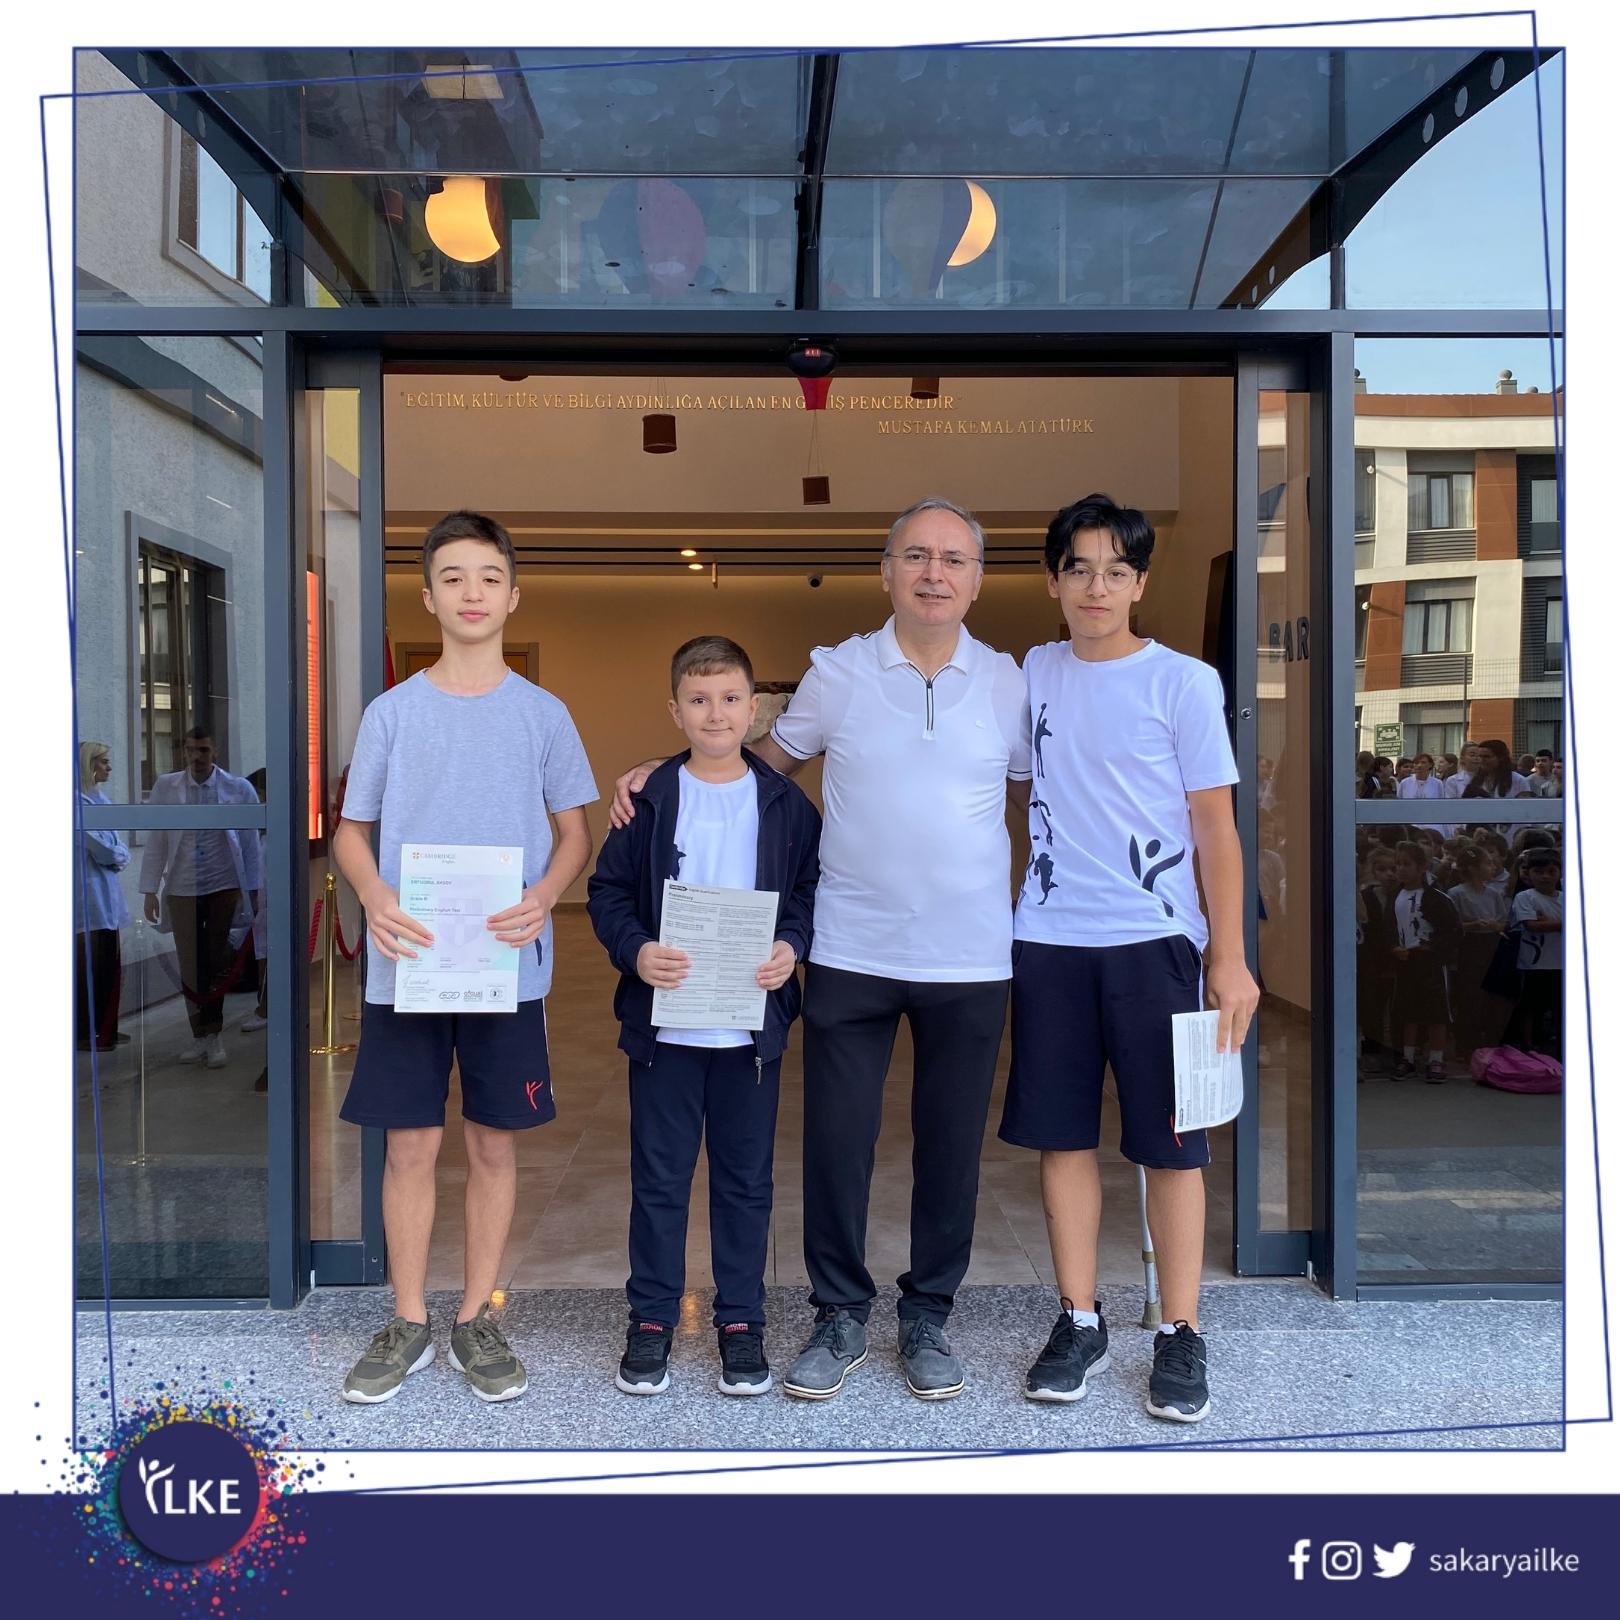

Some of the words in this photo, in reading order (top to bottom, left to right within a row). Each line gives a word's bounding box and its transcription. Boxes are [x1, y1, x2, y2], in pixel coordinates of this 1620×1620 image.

[471, 391, 539, 409] KÜLTÜR
[542, 394, 564, 409] VE
[567, 392, 612, 410] BİLGİ
[616, 393, 703, 410] AYDINLIĞA
[707, 395, 767, 413] AÇILAN
[770, 395, 791, 410] EN
[795, 395, 845, 412] GİŞ
[877, 419, 953, 435] MUSTAFA
[957, 418, 1014, 434] KEMAL
[1017, 417, 1095, 434] ATATÜRK
